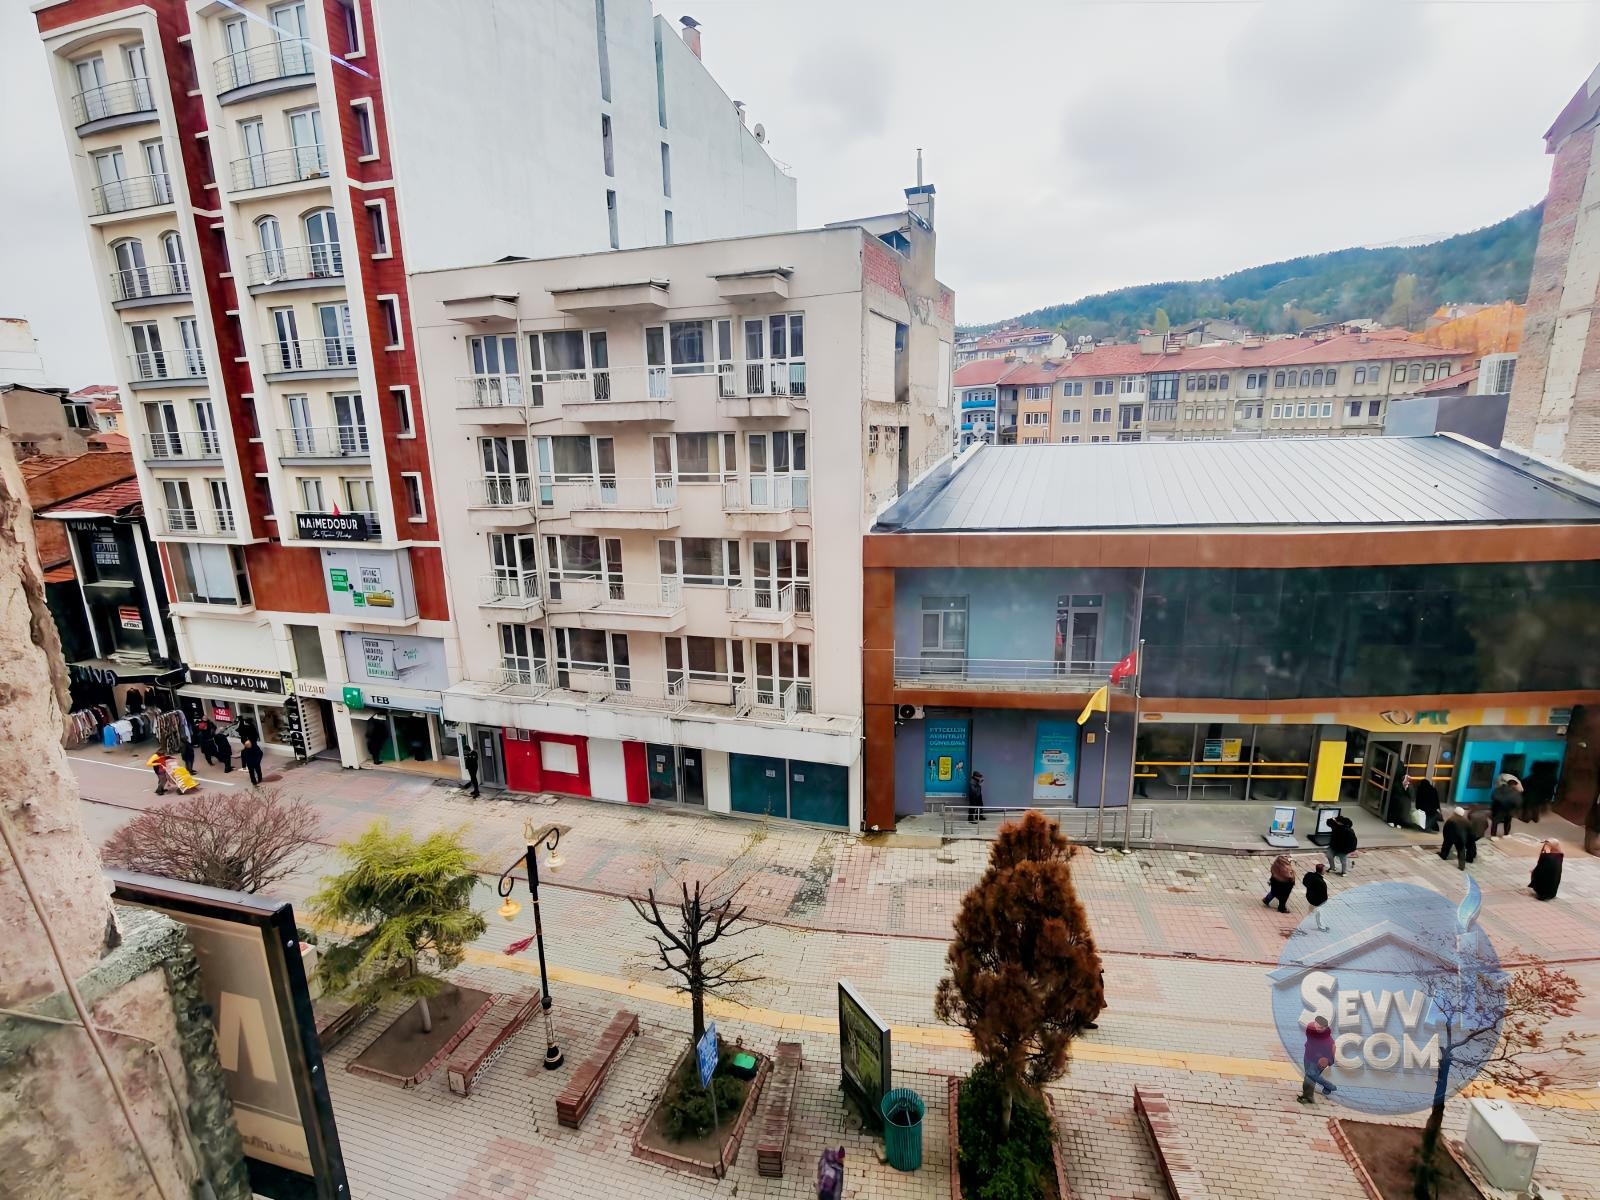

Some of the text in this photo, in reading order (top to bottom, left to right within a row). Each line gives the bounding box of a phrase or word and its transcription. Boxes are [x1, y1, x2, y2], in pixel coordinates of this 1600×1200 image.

[205, 673, 269, 690] ADIM ADIM
[370, 695, 390, 705] TEB
